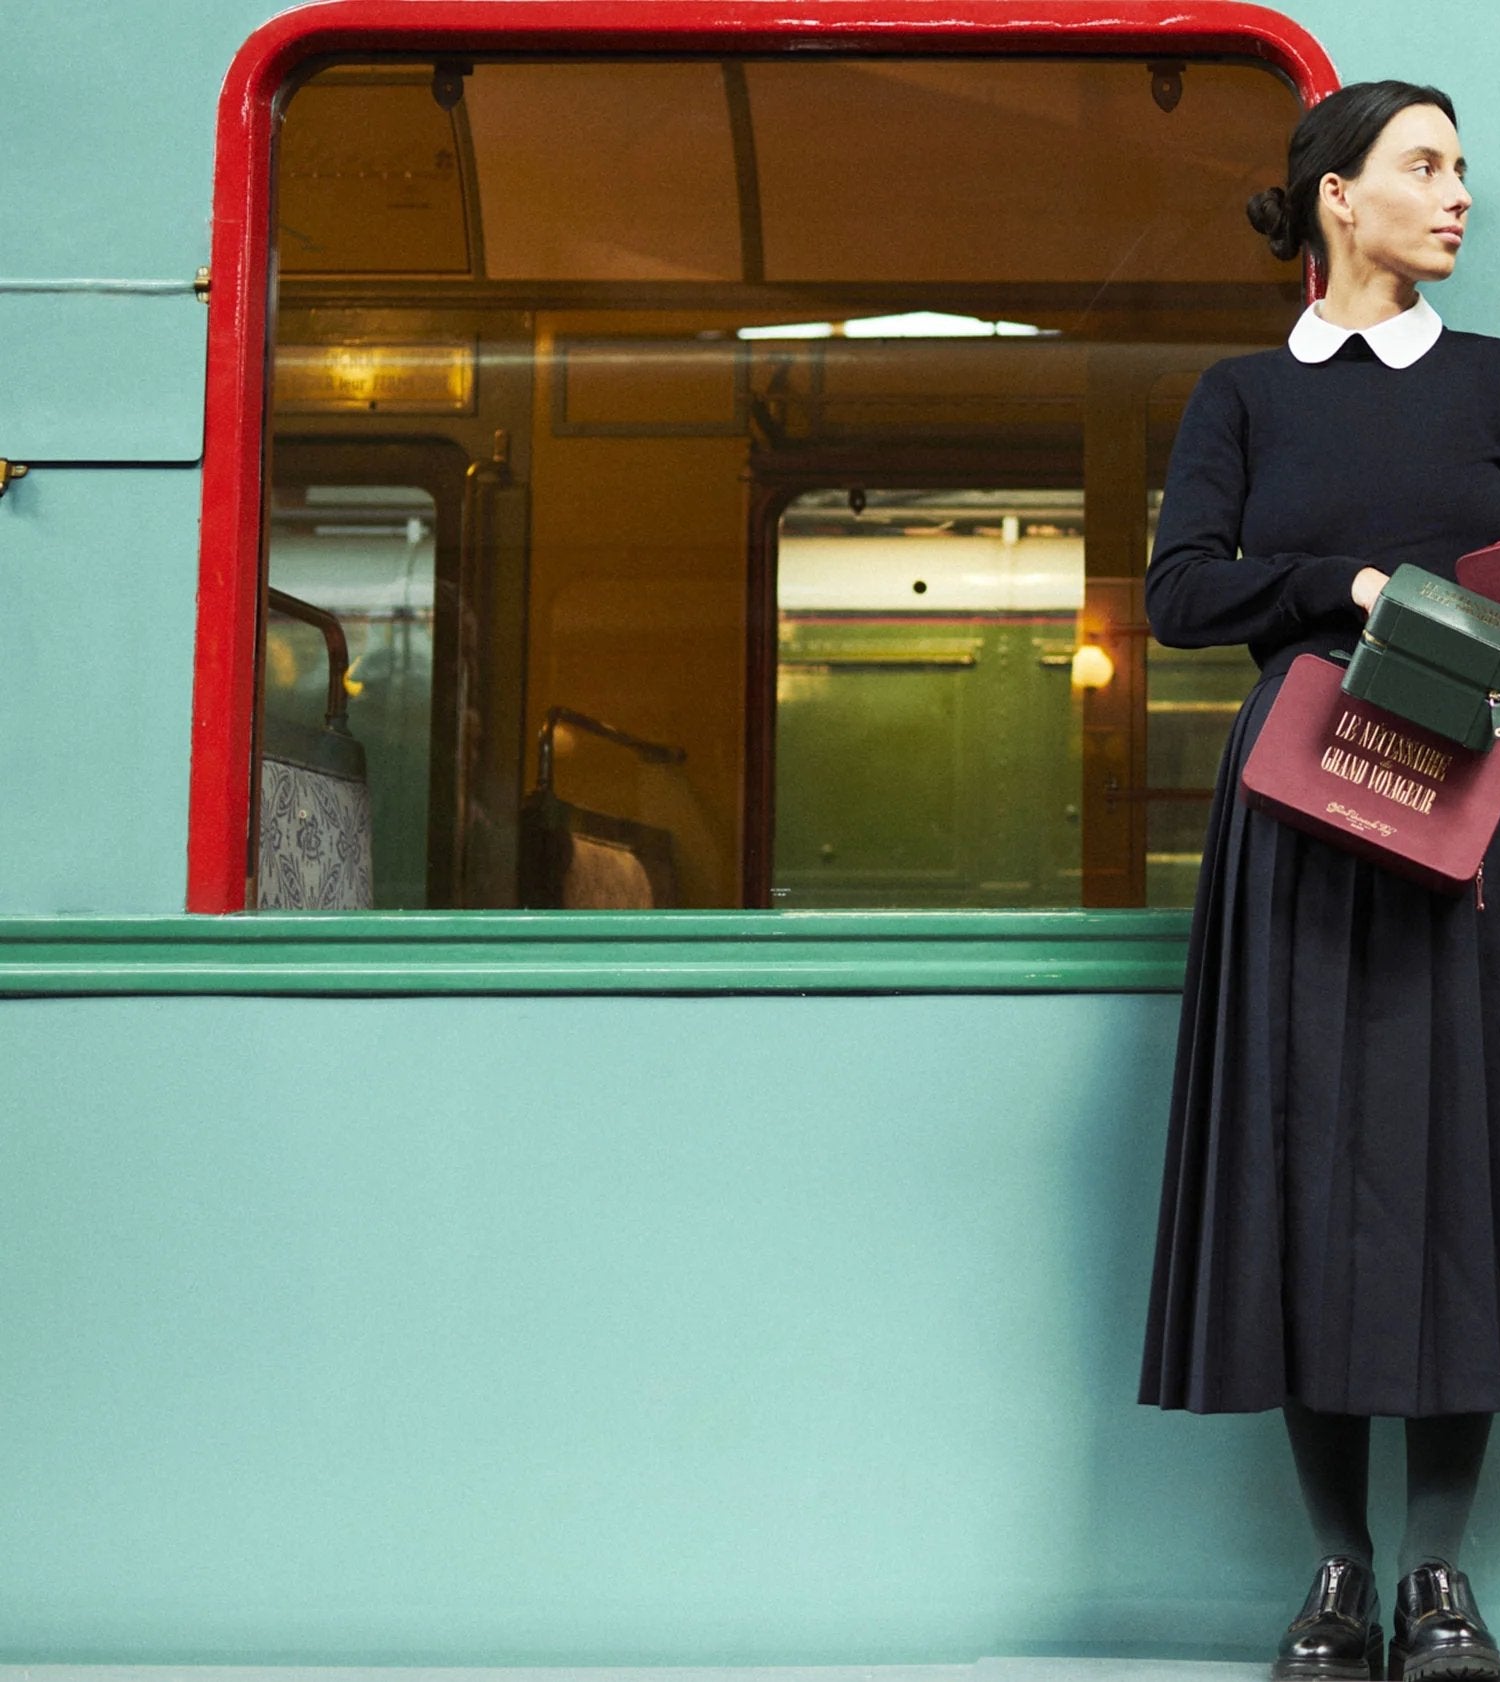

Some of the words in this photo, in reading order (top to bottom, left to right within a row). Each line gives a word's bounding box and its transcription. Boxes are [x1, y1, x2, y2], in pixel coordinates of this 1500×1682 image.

[1335, 711, 1362, 741] LE
[1320, 746, 1369, 785] GRAND
[1367, 765, 1437, 815] VOYAGEUR
